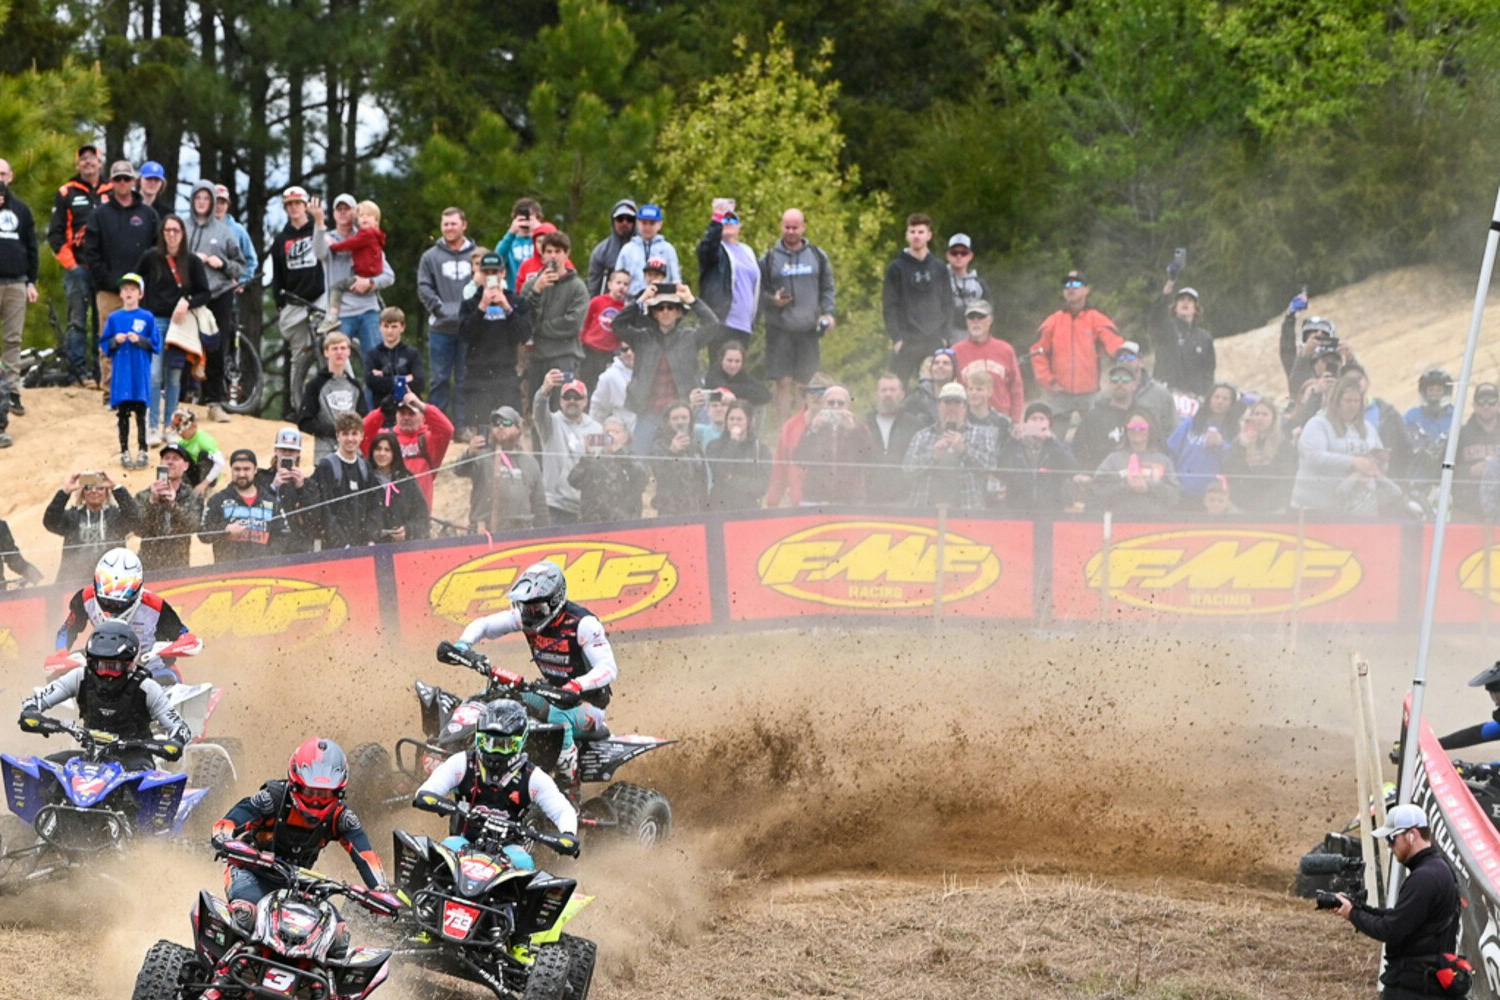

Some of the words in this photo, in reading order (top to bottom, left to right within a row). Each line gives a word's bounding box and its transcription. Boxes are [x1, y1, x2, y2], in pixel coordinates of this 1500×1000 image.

[761, 533, 992, 586] FMF
[1087, 541, 1353, 590] FMF
[848, 586, 904, 600] RACING
[1190, 593, 1252, 607] RACING
[262, 966, 296, 992] 3
